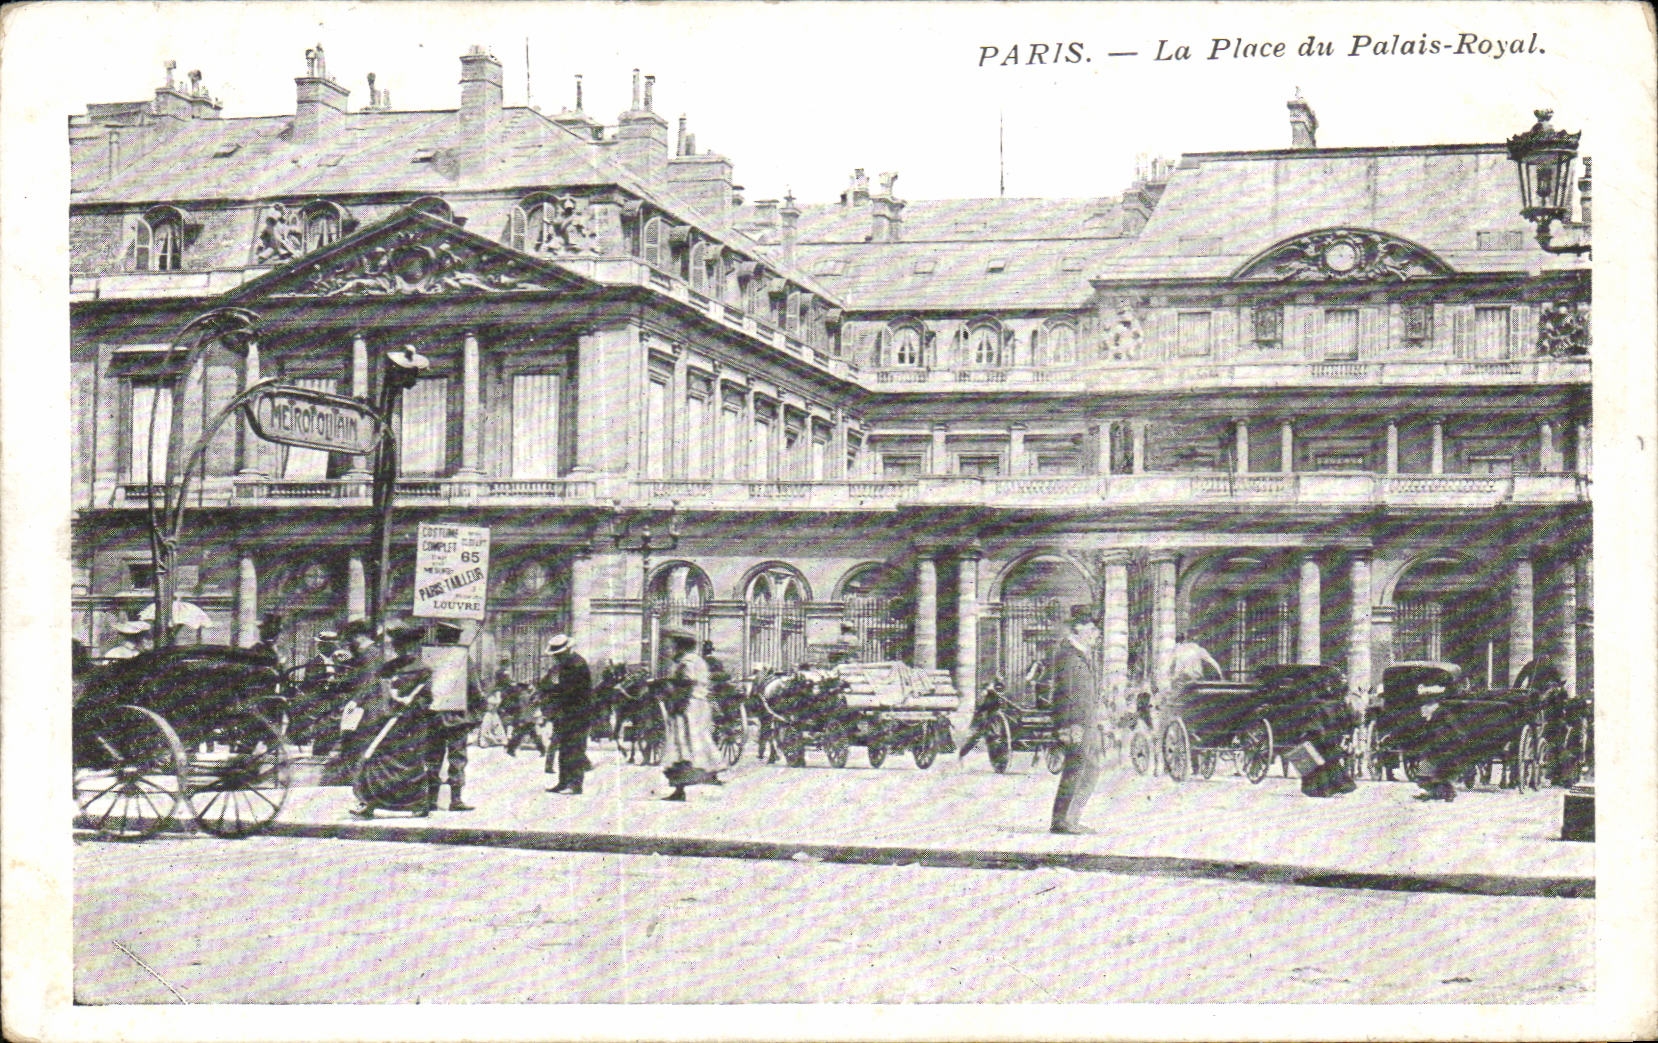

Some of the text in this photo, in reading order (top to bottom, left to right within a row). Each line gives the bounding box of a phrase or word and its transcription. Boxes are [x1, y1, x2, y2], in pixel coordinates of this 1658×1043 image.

[422, 527, 459, 539] COSTUME
[422, 541, 457, 553] COMPLET
[461, 551, 481, 564] 65
[433, 600, 481, 611] LOUVRE
